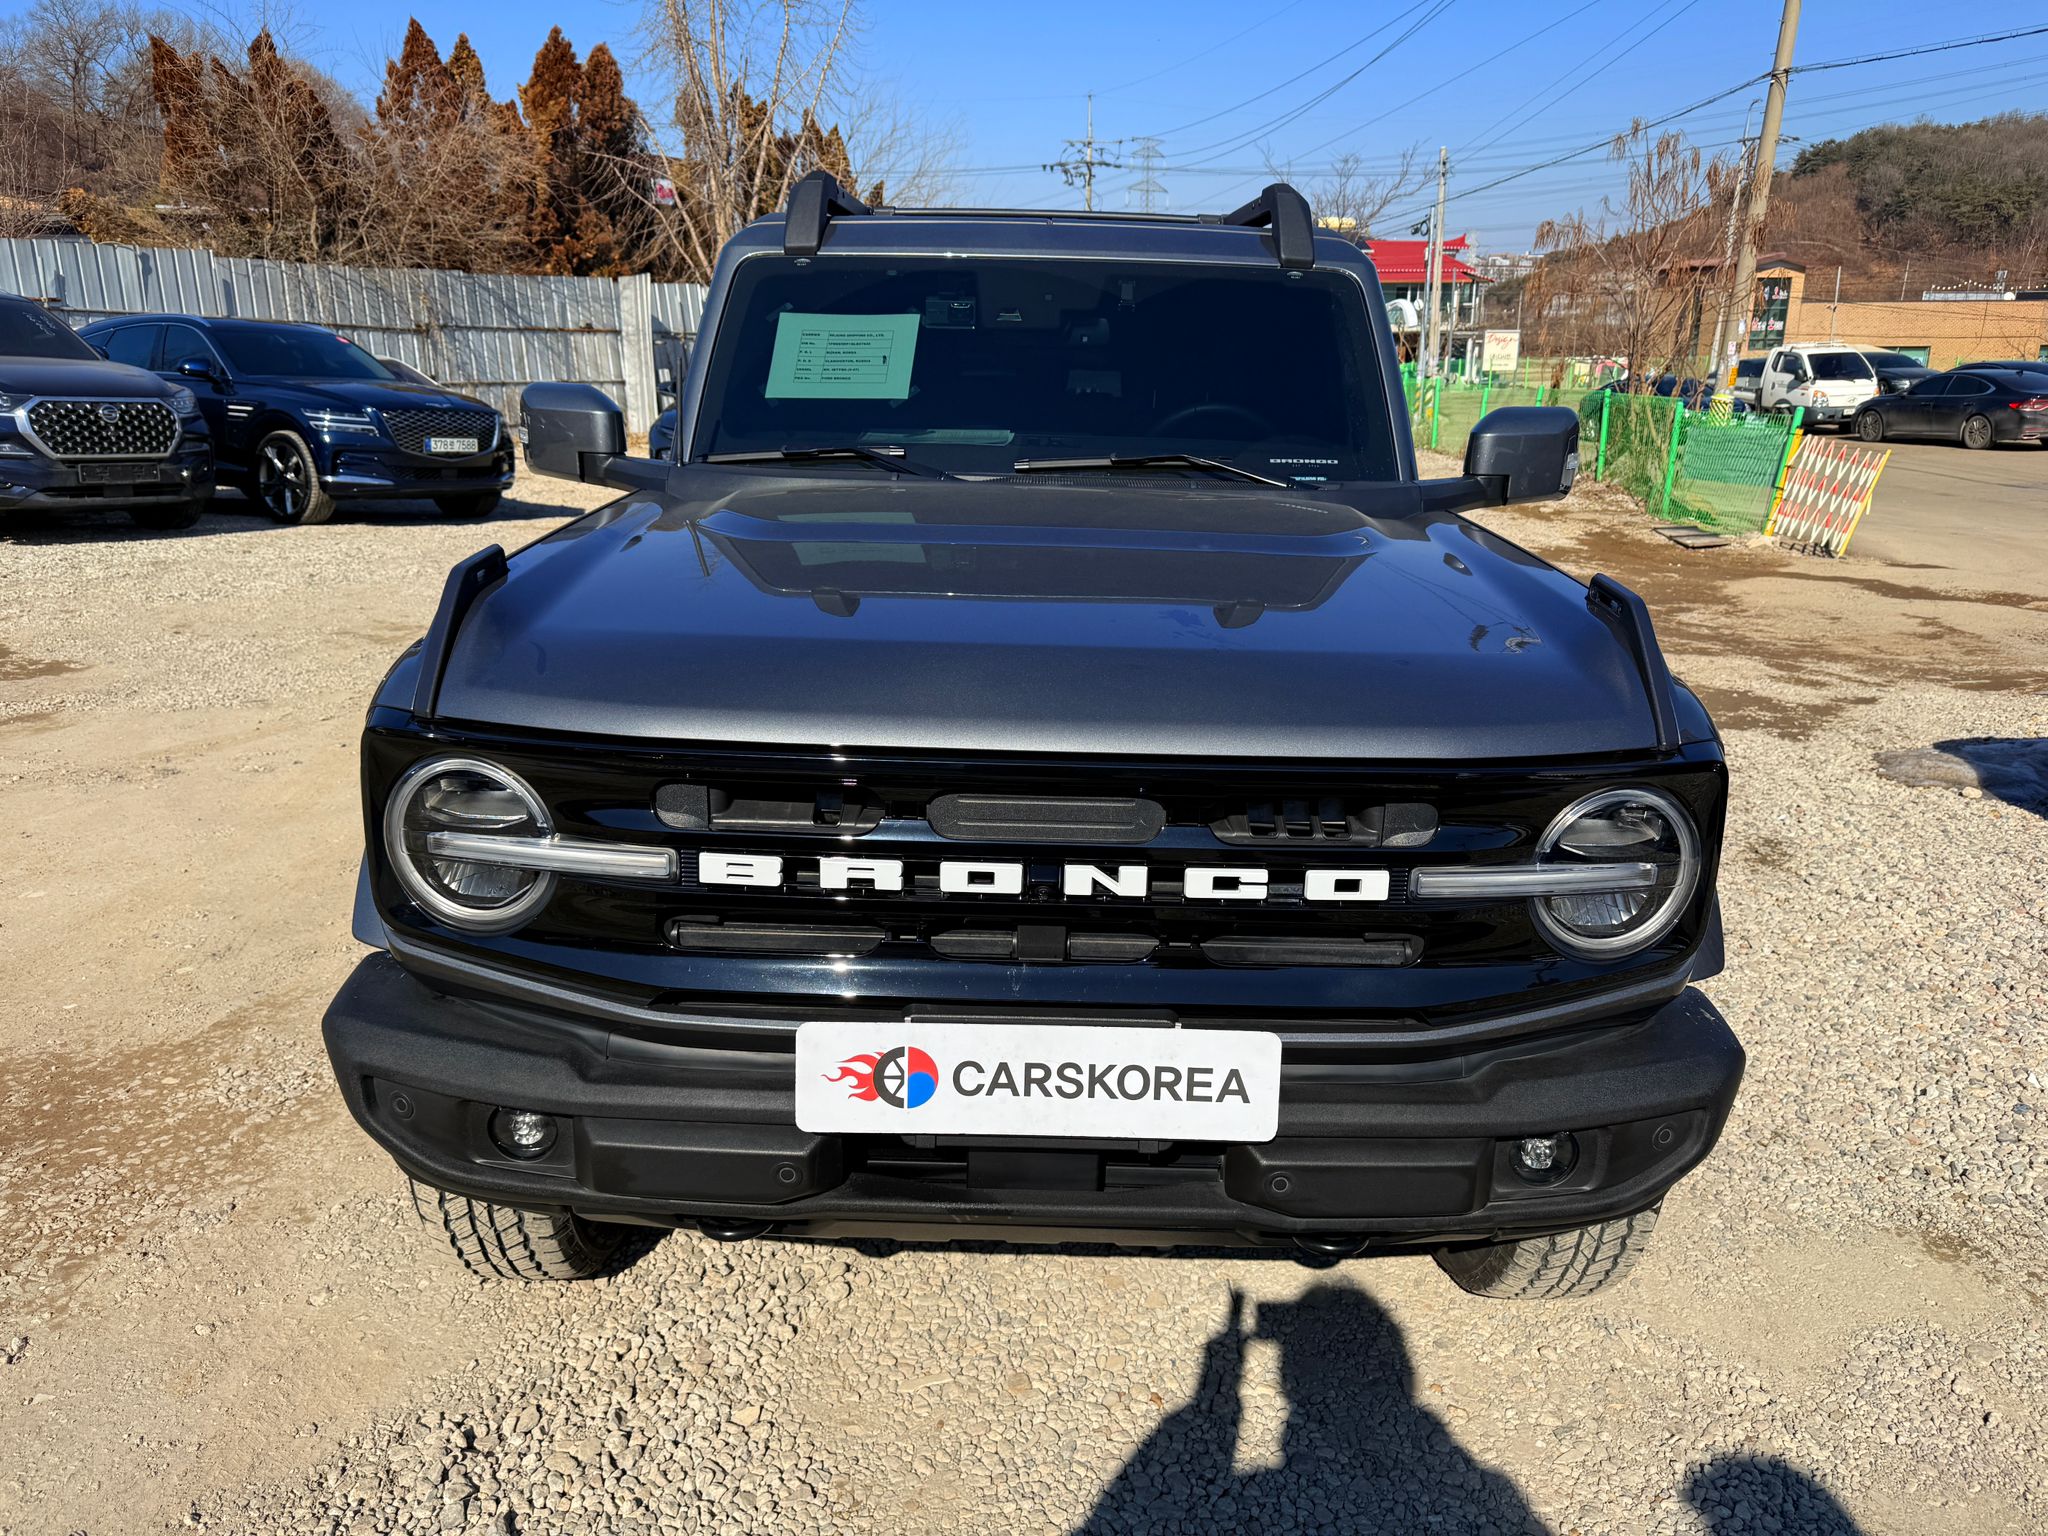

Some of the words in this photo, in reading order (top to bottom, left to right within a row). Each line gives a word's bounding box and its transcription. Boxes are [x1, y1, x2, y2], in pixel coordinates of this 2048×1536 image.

[455, 439, 477, 450] 7588
[699, 851, 1391, 901] BRONCO
[952, 1060, 1251, 1104] CARSKOREA
